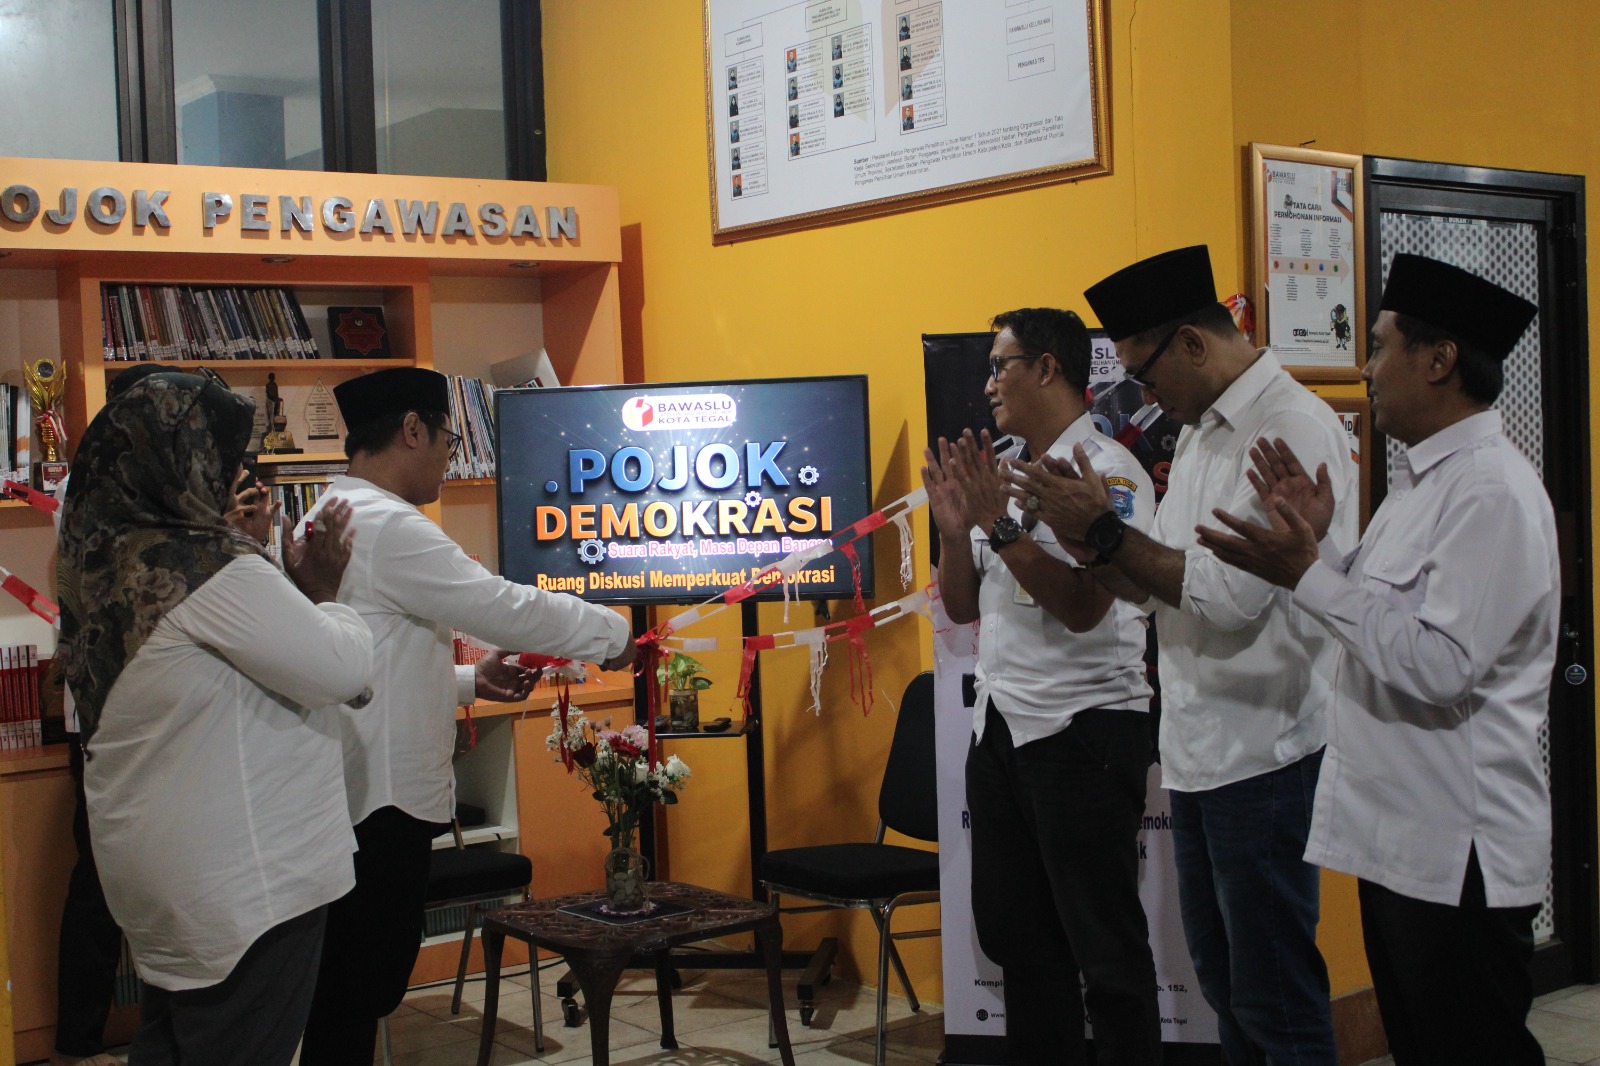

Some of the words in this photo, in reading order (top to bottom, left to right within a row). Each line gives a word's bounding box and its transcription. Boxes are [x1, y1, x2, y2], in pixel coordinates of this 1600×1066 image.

[1272, 171, 1296, 180] BAWASLU
[1292, 201, 1307, 210] TATA
[1307, 203, 1322, 211] CARA
[203, 191, 578, 241] PENGAWASAN
[1274, 210, 1313, 221] PERMOHONAN
[1313, 214, 1342, 223] INFORMASI
[1091, 347, 1120, 359] SL
[658, 400, 732, 412] BAWASLU
[658, 416, 690, 424] KOTA
[695, 415, 731, 423] TEGAL
[569, 441, 790, 493] POJOK
[536, 496, 832, 541] DEMOKRASI
[608, 543, 647, 558] Suara
[650, 540, 698, 560] Rakyat,
[701, 540, 736, 555] Masa
[738, 538, 780, 557] Depan
[537, 573, 585, 594] Ruang
[588, 569, 645, 590] Diskusi
[650, 567, 746, 591] Memperkuat
[974, 979, 1004, 988] Kompl
[1168, 984, 1188, 993] 152,
